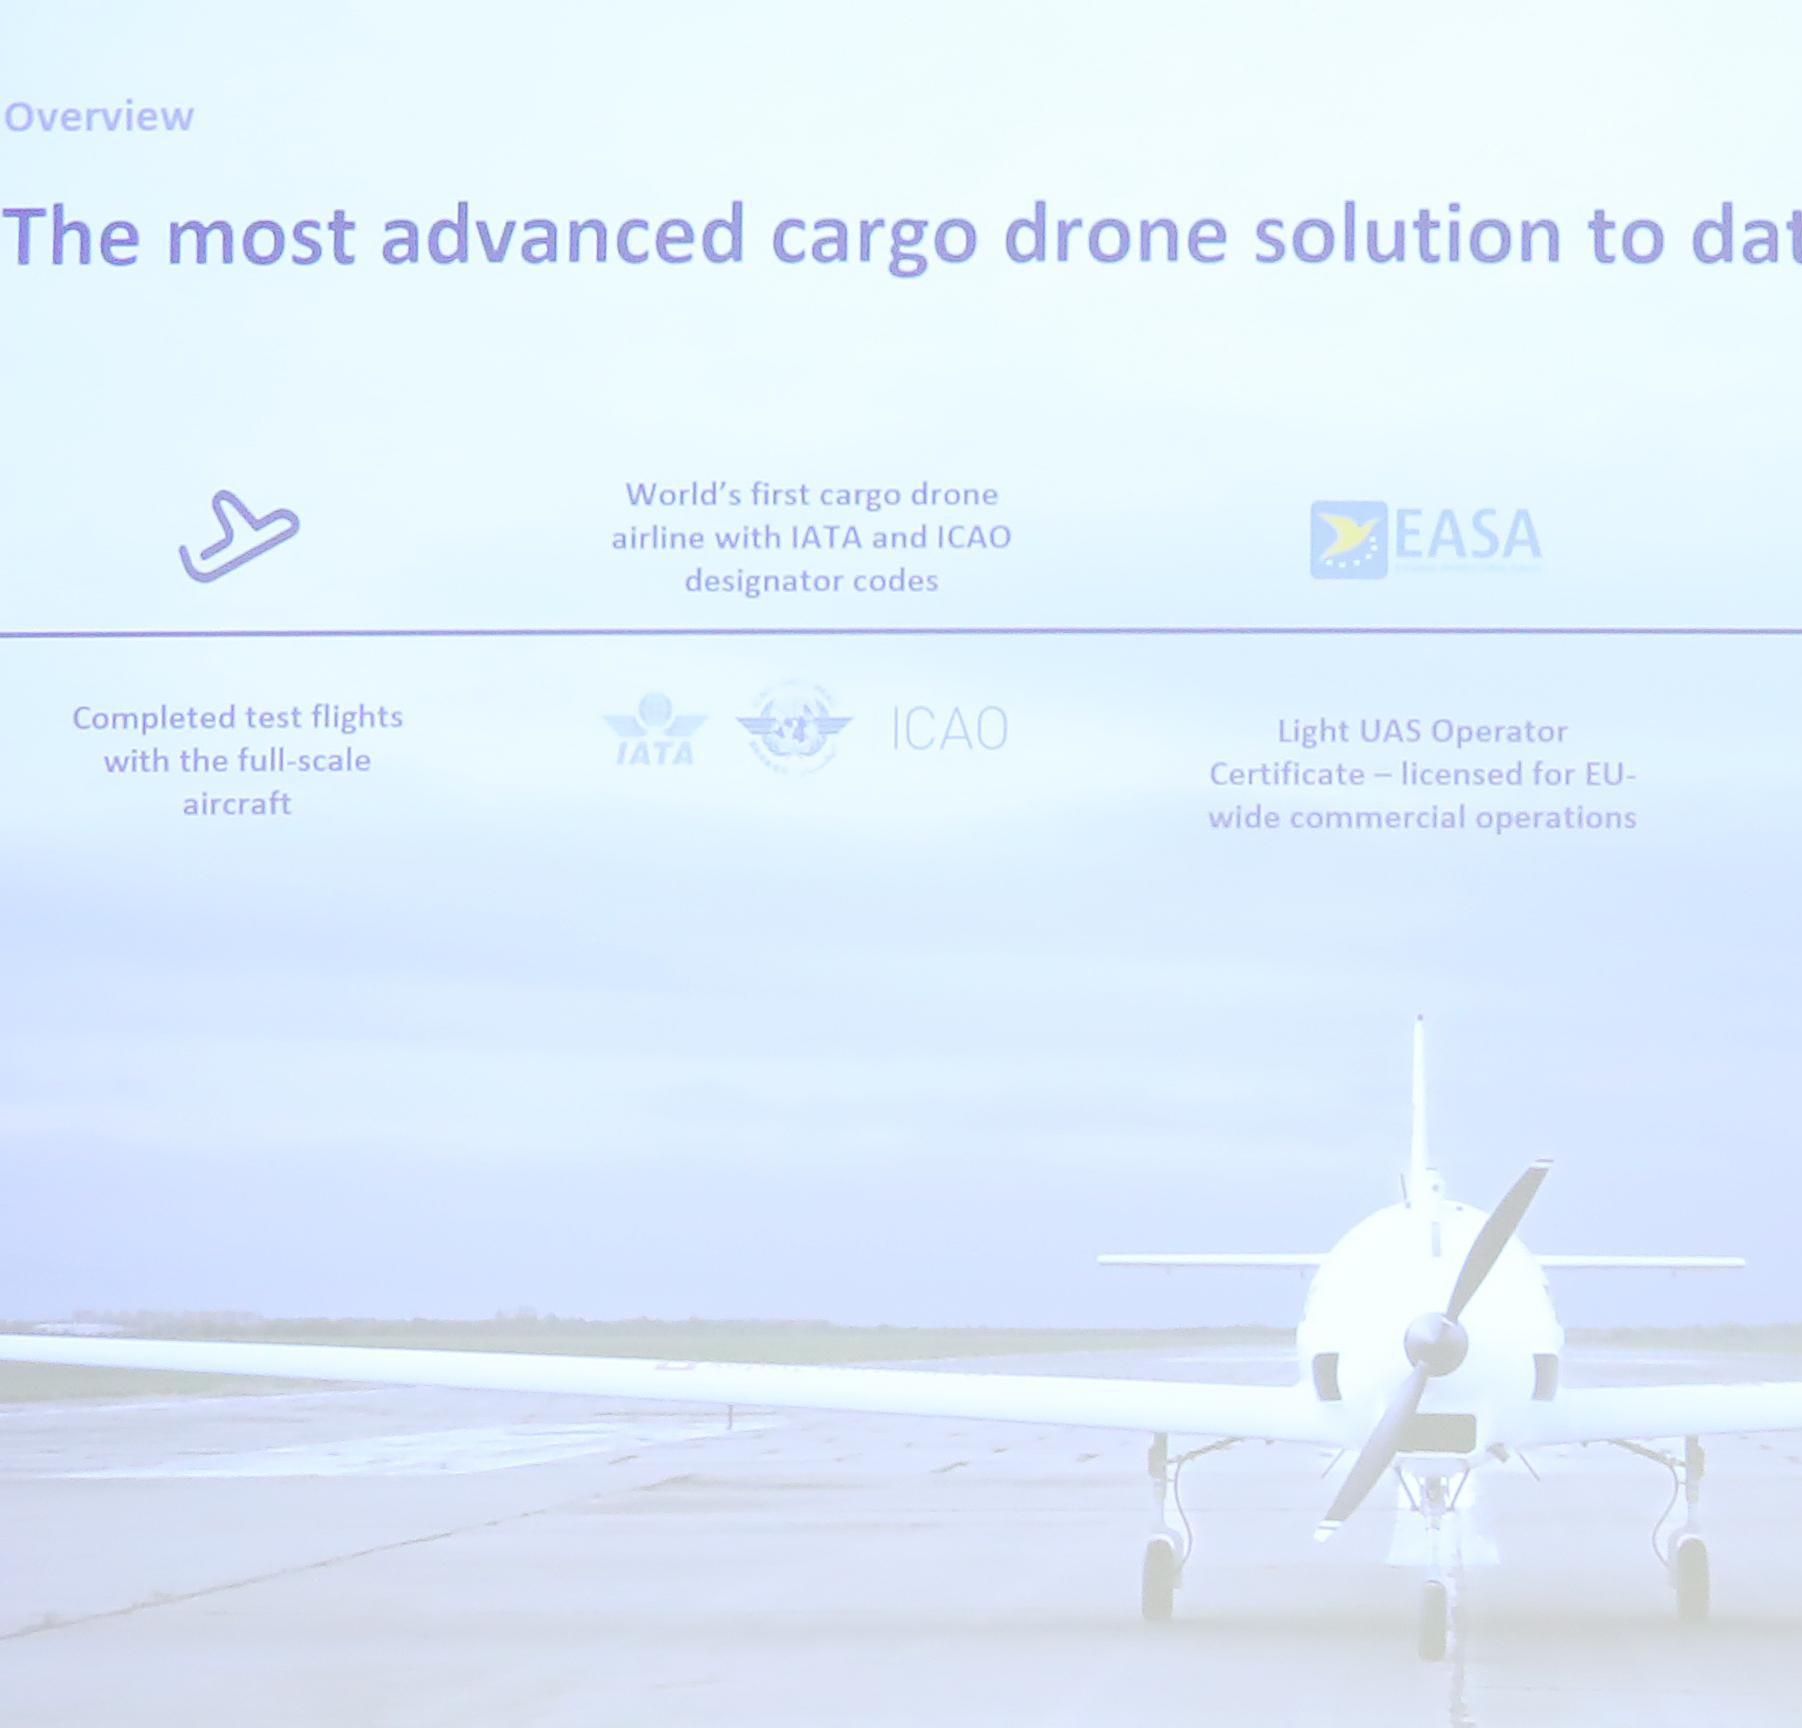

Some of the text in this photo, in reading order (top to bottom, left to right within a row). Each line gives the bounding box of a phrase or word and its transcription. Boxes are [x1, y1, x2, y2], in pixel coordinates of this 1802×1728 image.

[4, 100, 195, 133] Overview
[3, 203, 140, 266] The
[168, 209, 356, 266] most
[381, 201, 744, 265] advanced
[772, 213, 980, 279] cargo
[1004, 200, 1227, 264] drone
[1255, 200, 1562, 264] solution
[1588, 208, 1666, 266] to
[750, 480, 811, 507] first
[818, 488, 901, 516] cargo
[909, 480, 999, 507] drone
[611, 523, 1012, 551] airline with IATA and ICAO
[1395, 506, 1543, 560] EASA
[684, 566, 939, 598] designator codes
[72, 703, 404, 737] Completed test flights
[894, 706, 1009, 751] ICAO
[1278, 717, 1569, 752] Light UAS Operator
[103, 745, 371, 774] with the full-scale
[615, 741, 694, 766] IATA
[1209, 759, 1366, 788] Certificate
[1401, 759, 1525, 788] licensed
[1533, 759, 1576, 788] for
[1585, 762, 1638, 788] EU-
[183, 787, 292, 817] aircraft
[1208, 802, 1638, 834] wide commercial operations
